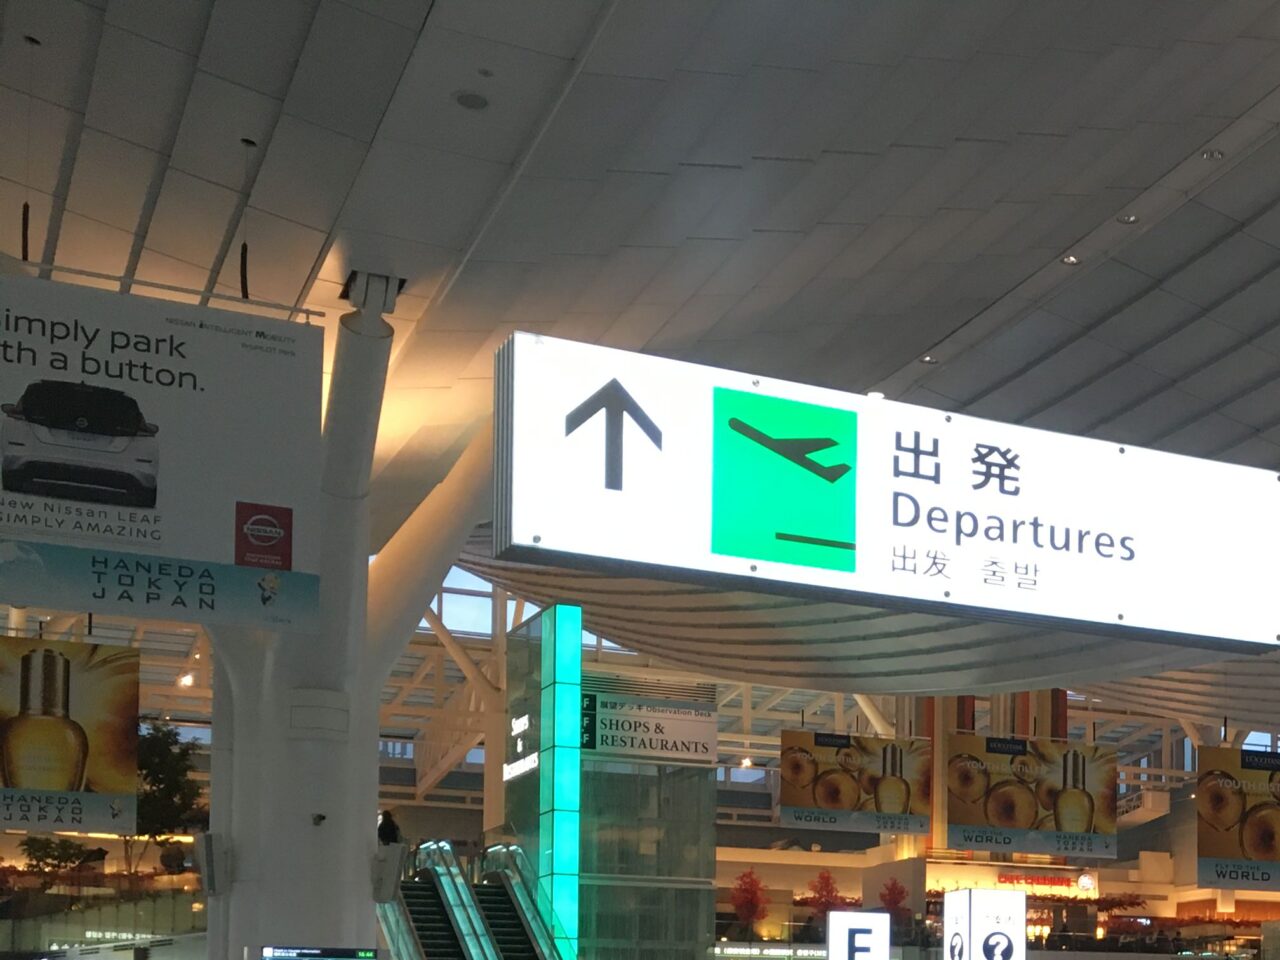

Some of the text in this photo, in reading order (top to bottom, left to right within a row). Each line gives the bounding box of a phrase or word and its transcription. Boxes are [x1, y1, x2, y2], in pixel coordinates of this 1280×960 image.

[0, 308, 186, 359] imply park
[50, 351, 68, 371] a
[81, 351, 205, 391] button.
[44, 502, 107, 520] Nissan
[117, 511, 162, 526] LEAF
[0, 511, 162, 541] IMPLY AMAZING
[892, 491, 1135, 561] Departures
[92, 555, 215, 581] HANEDA
[892, 544, 950, 580] 出发
[92, 571, 215, 596] TOKYO
[92, 587, 215, 610] JAPAN
[646, 706, 692, 717] Observation
[600, 717, 665, 735] SHOPS &
[600, 734, 709, 754] RESTAURANTS
[1217, 778, 1256, 790] YOUTH
[3, 794, 82, 805] HANEDA
[3, 803, 82, 815] TOKYO
[3, 813, 82, 824] JAPAN
[794, 815, 837, 823] WORLD
[963, 834, 1012, 845] WORLD
[1215, 869, 1271, 881] WORLD
